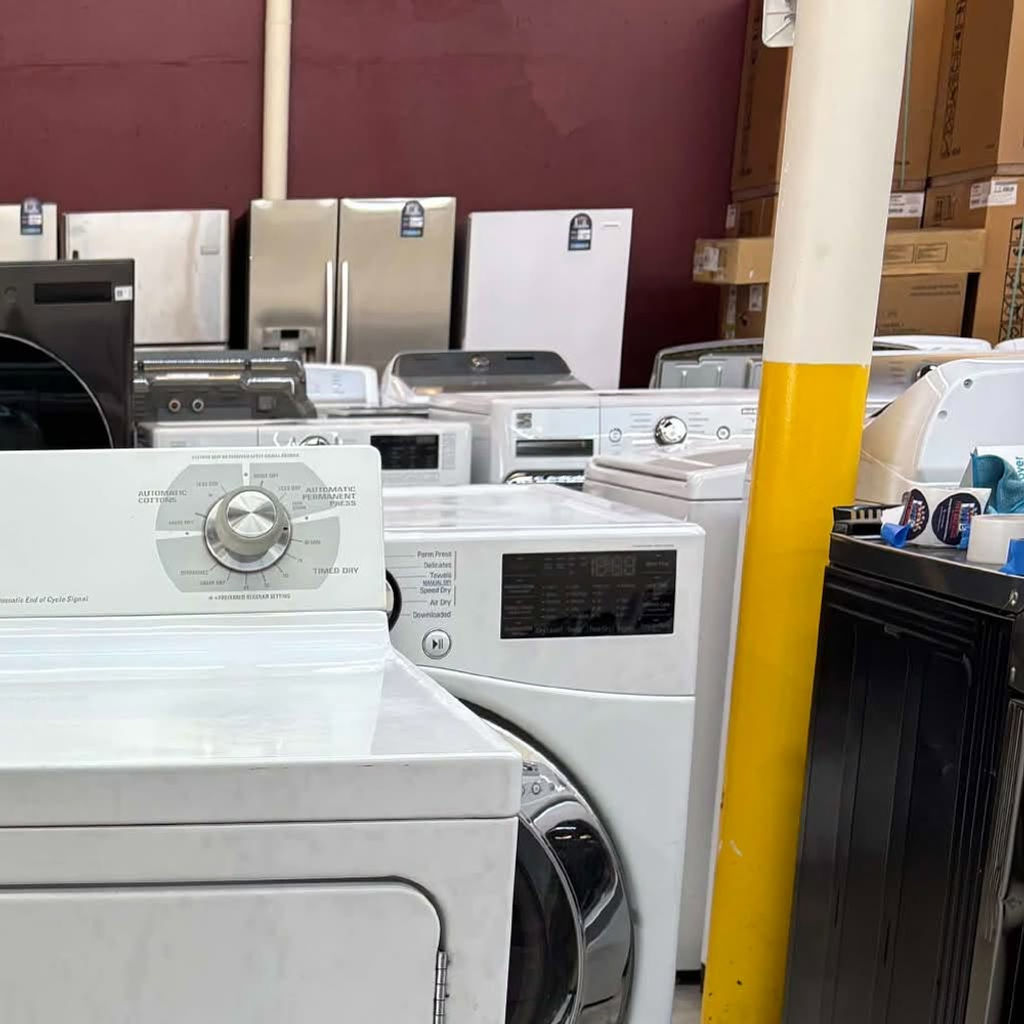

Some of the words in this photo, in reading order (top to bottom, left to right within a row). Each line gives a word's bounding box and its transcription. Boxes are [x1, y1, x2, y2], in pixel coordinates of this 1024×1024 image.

[137, 489, 187, 497] AUTOMATIC
[302, 493, 356, 501] PERMANENT
[313, 567, 341, 575] TIMED
[47, 595, 66, 605] Cycle
[67, 595, 89, 604] Signal
[412, 611, 452, 619] Downloaded
